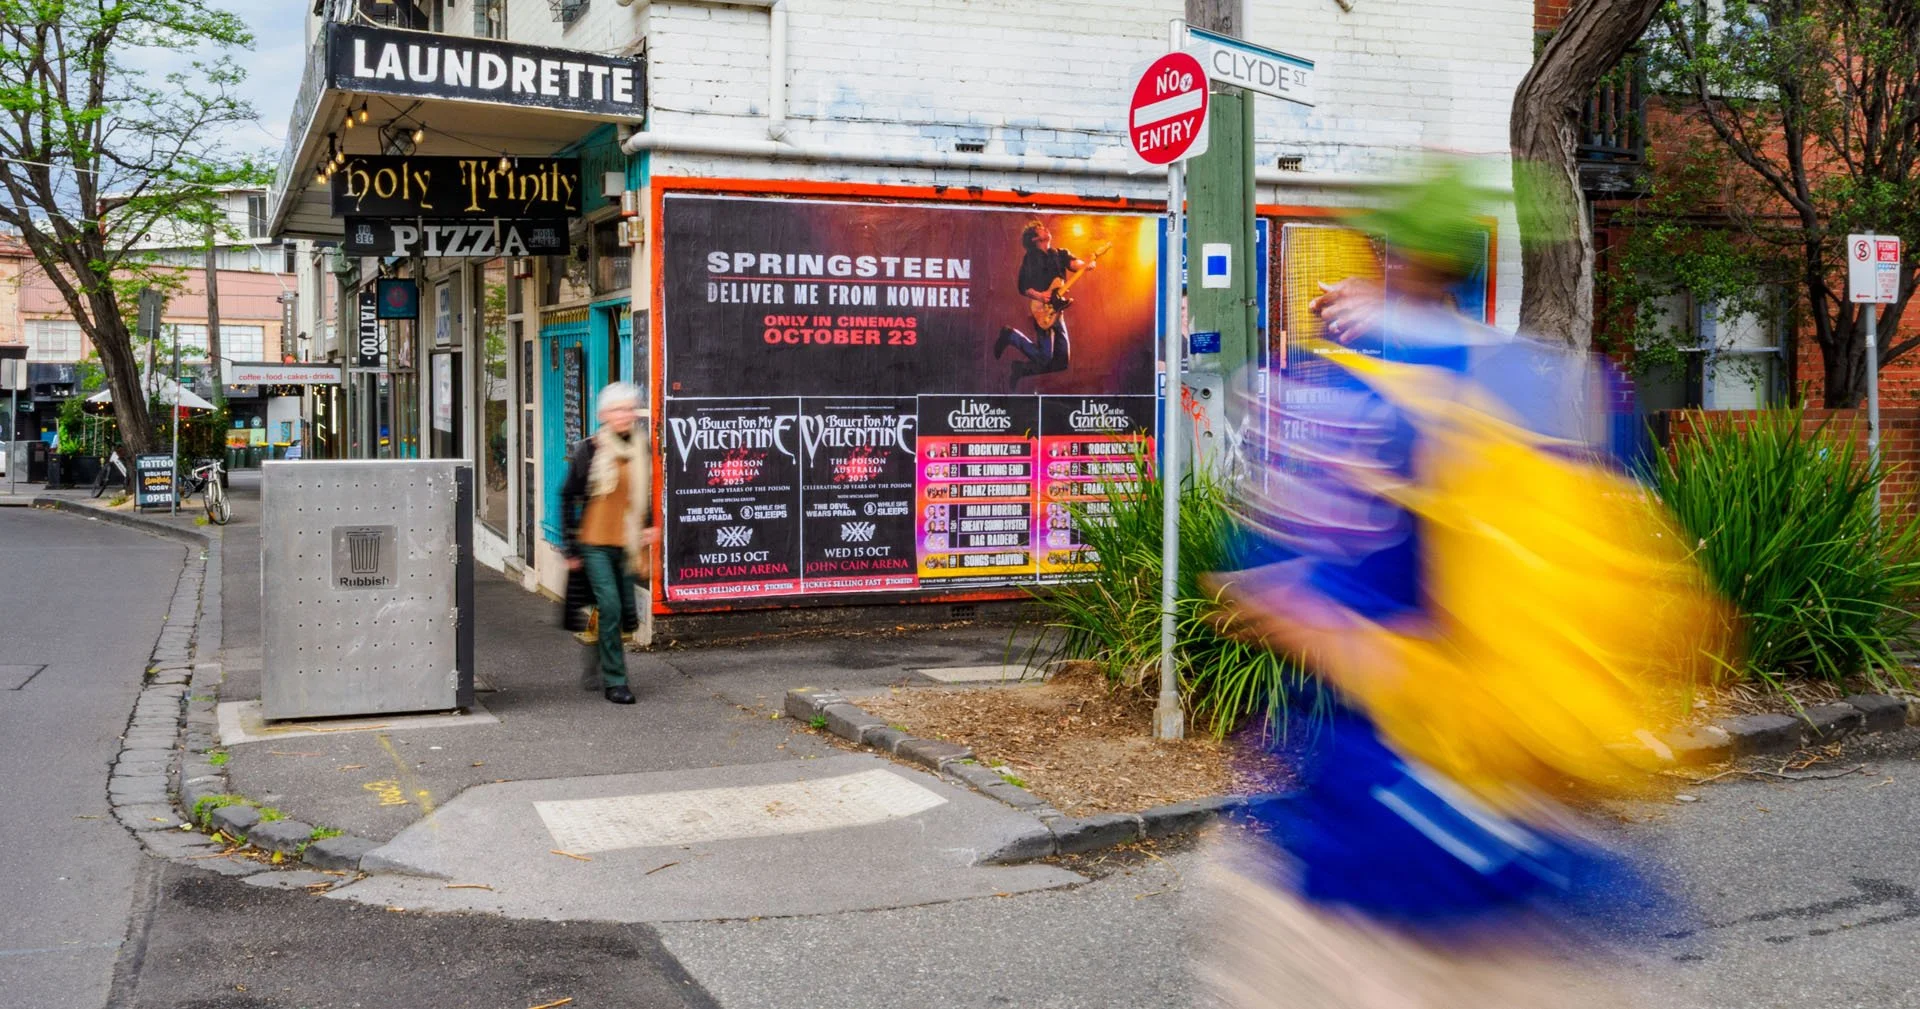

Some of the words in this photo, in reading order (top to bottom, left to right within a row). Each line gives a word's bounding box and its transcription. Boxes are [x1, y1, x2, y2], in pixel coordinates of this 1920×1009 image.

[354, 39, 633, 103] LAUNDRETTE
[1213, 50, 1290, 91] CLYDE
[1294, 70, 1307, 86] ST
[1156, 69, 1180, 96] NO
[1139, 117, 1195, 152] ENTRY
[459, 160, 577, 214] Trinity
[356, 234, 373, 243] SEC
[390, 225, 529, 257] PIZZA
[707, 251, 971, 279] SPRINGSTEEN
[707, 283, 784, 304] DELIVER
[794, 284, 819, 305] ME
[829, 285, 877, 306] FROM
[887, 286, 970, 308] NOWHERE
[764, 315, 808, 328] ONLY
[813, 316, 832, 327] IN
[837, 316, 917, 328] CINEMAS
[361, 304, 379, 357] TATTOO
[763, 327, 881, 345] OCTOBER
[887, 329, 917, 346] 23
[239, 373, 261, 381] coffee
[266, 373, 282, 381] food
[287, 373, 308, 381] cakes
[312, 373, 335, 381] drinks
[266, 386, 298, 395] PIZZA
[961, 399, 990, 415] Live
[1082, 399, 1109, 415] Live
[948, 410, 1011, 429] Gardens
[1069, 410, 1129, 429] Gardens
[968, 444, 1008, 455] ROCKWIZ
[1088, 443, 1126, 455] ROCKWIZ
[140, 459, 174, 468] TATTOO
[704, 461, 722, 469] THE
[833, 466, 883, 474] AUSTRALIA
[967, 465, 982, 476] THE
[983, 464, 1007, 475] LIVING
[1008, 464, 1023, 475] END
[707, 469, 760, 477] AUSTRALIA
[963, 485, 987, 497] FRANZ
[987, 484, 1027, 496] FERDINAND
[147, 494, 172, 502] OPEN
[754, 510, 787, 519] SLEEPS
[877, 507, 909, 515] SLEEPS
[966, 505, 991, 516] MIAMI
[992, 504, 1022, 516] HORROR
[707, 513, 732, 521] PRADA
[961, 520, 984, 532] SNEAKY
[984, 520, 1004, 531] SOUND
[1004, 519, 1027, 530] SYSTEM
[969, 535, 985, 546] BAG
[987, 534, 1018, 546] RAIDERS
[700, 553, 727, 564] WED
[730, 552, 741, 562] 15
[744, 551, 769, 561] OCT
[824, 548, 850, 558] WED
[854, 548, 864, 557] 15
[866, 546, 891, 556] OCT
[805, 561, 837, 574] JOHN
[841, 560, 871, 571] CAIN
[872, 558, 909, 569] ARENA
[964, 555, 989, 566] SONGS
[995, 553, 1024, 565] CANYON
[680, 567, 713, 579] JOHN
[717, 565, 746, 577] CAIN
[750, 563, 788, 575] ARENA
[340, 576, 390, 586] Rubbish
[801, 580, 832, 588] TICKETS
[833, 579, 864, 587] SELLING
[865, 578, 881, 586] FAST
[676, 587, 707, 596] TICKETS
[709, 585, 741, 593] SELLING
[743, 584, 760, 592] FAST
